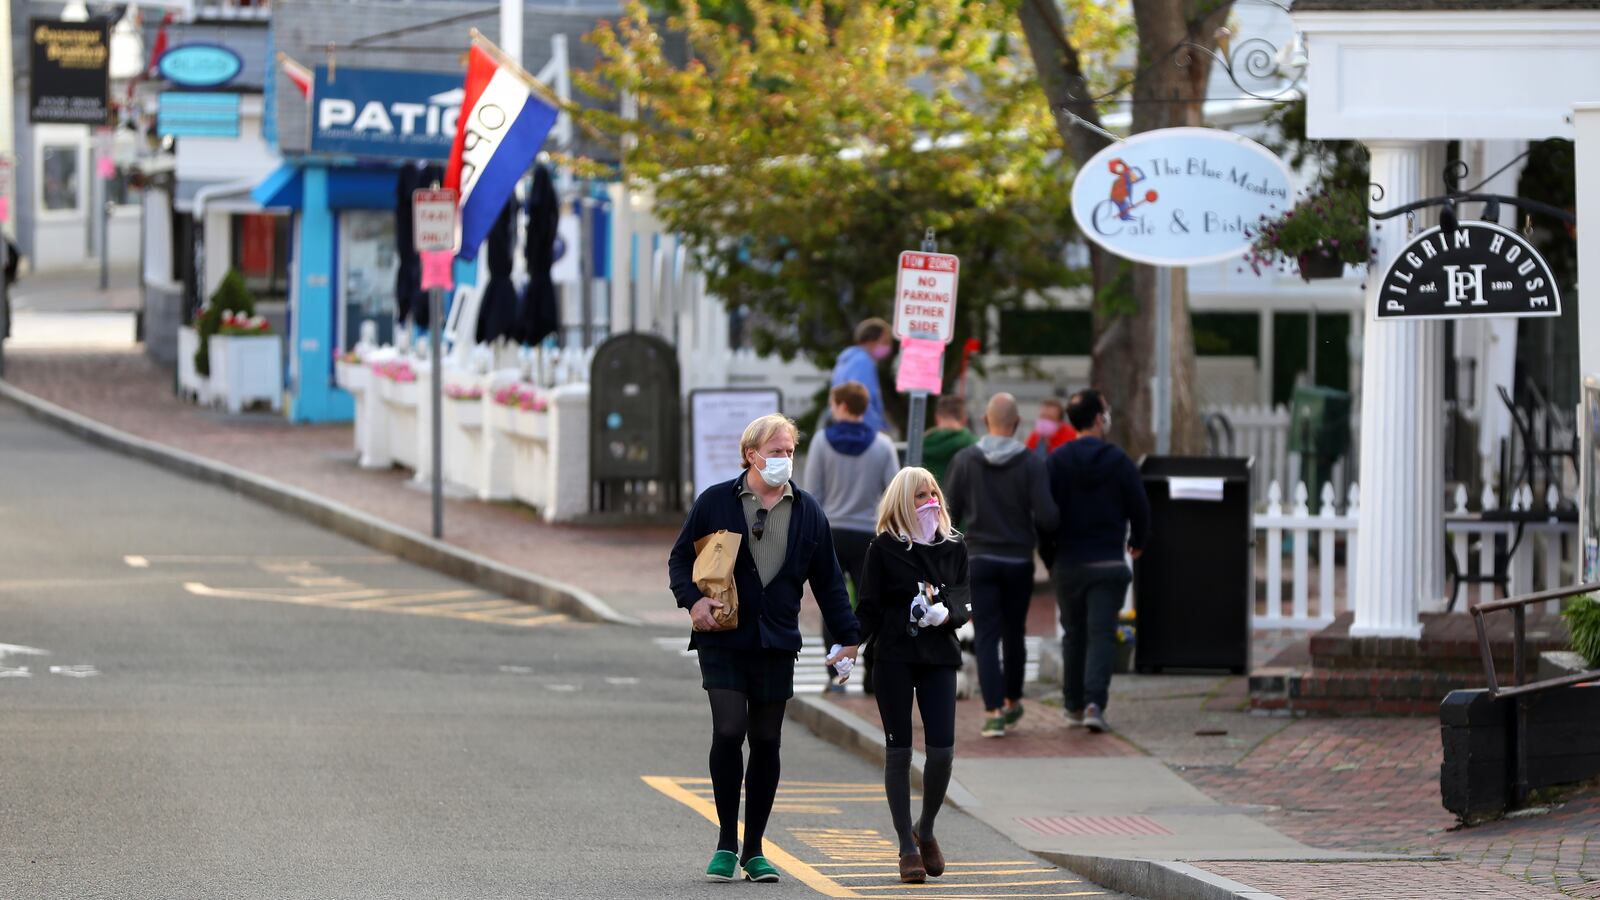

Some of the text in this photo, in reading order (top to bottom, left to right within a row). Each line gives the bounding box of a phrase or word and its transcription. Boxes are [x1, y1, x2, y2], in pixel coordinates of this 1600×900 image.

[1150, 157, 1287, 199] The Blue Monkey
[1169, 208, 1195, 235] &
[903, 255, 955, 271] TOW ZONE
[1386, 228, 1548, 312] PILGRIM HOUSE
[917, 276, 936, 287] NO
[1491, 281, 1513, 290] 1810
[903, 289, 949, 303] PARKING
[905, 305, 944, 317] EITHER
[909, 320, 939, 332] SIDE
